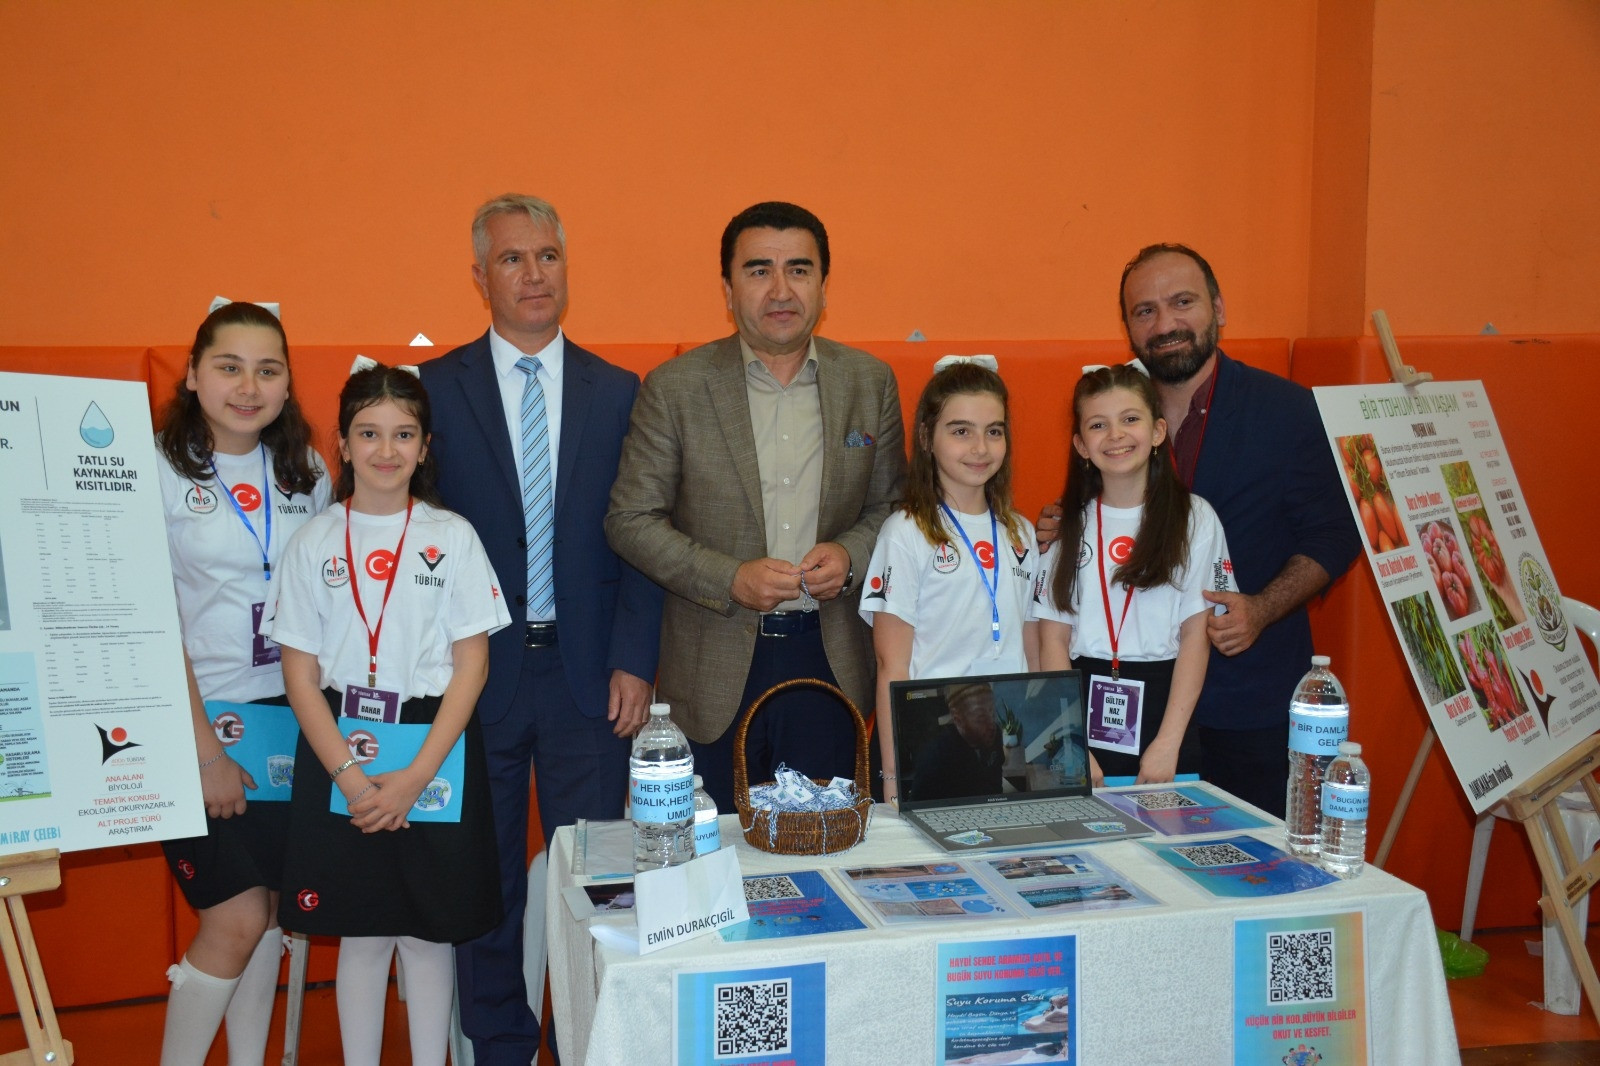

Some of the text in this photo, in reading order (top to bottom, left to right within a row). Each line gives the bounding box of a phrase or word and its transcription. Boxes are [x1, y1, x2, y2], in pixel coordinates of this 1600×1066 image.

[0, 400, 20, 412] UN
[1360, 395, 1380, 420] BİR
[1378, 396, 1415, 417] TOHUM
[1429, 394, 1459, 417] YAŞAM
[78, 455, 125, 466] TATLI SU
[73, 468, 138, 480] KAYNAKLARI
[75, 480, 136, 492] KISITLIDIR.
[278, 504, 308, 514] TÜBİTAK
[415, 574, 446, 588] TÜBİTAK
[1105, 695, 1125, 706] GÜLTEN
[1109, 707, 1120, 715] NAZ
[1297, 722, 1346, 734] BİR DAMLA
[1318, 737, 1346, 747] GELE
[105, 773, 145, 782] ANA ALANI
[108, 781, 143, 792] BİYOLOJİ
[640, 783, 661, 793] HER
[93, 793, 160, 806] TEMATİK KONUSU
[1336, 797, 1362, 805] BUGÜN
[78, 800, 176, 817] EKOLOJİK OKURYAZARLIK
[667, 807, 692, 820] UMUT
[1329, 804, 1354, 813] DAMLA
[97, 814, 162, 828] ALT PROJE TÜRÜ
[34, 826, 62, 843] ÇELEBİ
[108, 825, 153, 836] ARAŞTIRMA
[648, 909, 736, 945] EMİN DURAKÇIGİL
[950, 955, 972, 968] HAYDİ
[973, 956, 996, 966] SENDE
[947, 969, 971, 982] BUGÜN
[973, 969, 992, 980] SUYU
[946, 997, 971, 1007] Suyu
[974, 995, 1017, 1004] Koruma
[1245, 1014, 1269, 1029] KÜÇÜK
[1272, 1013, 1284, 1026] BİR
[1328, 1008, 1356, 1021] BİLGİLER
[1273, 1030, 1291, 1039] OKUT
[1294, 1029, 1302, 1038] VE
